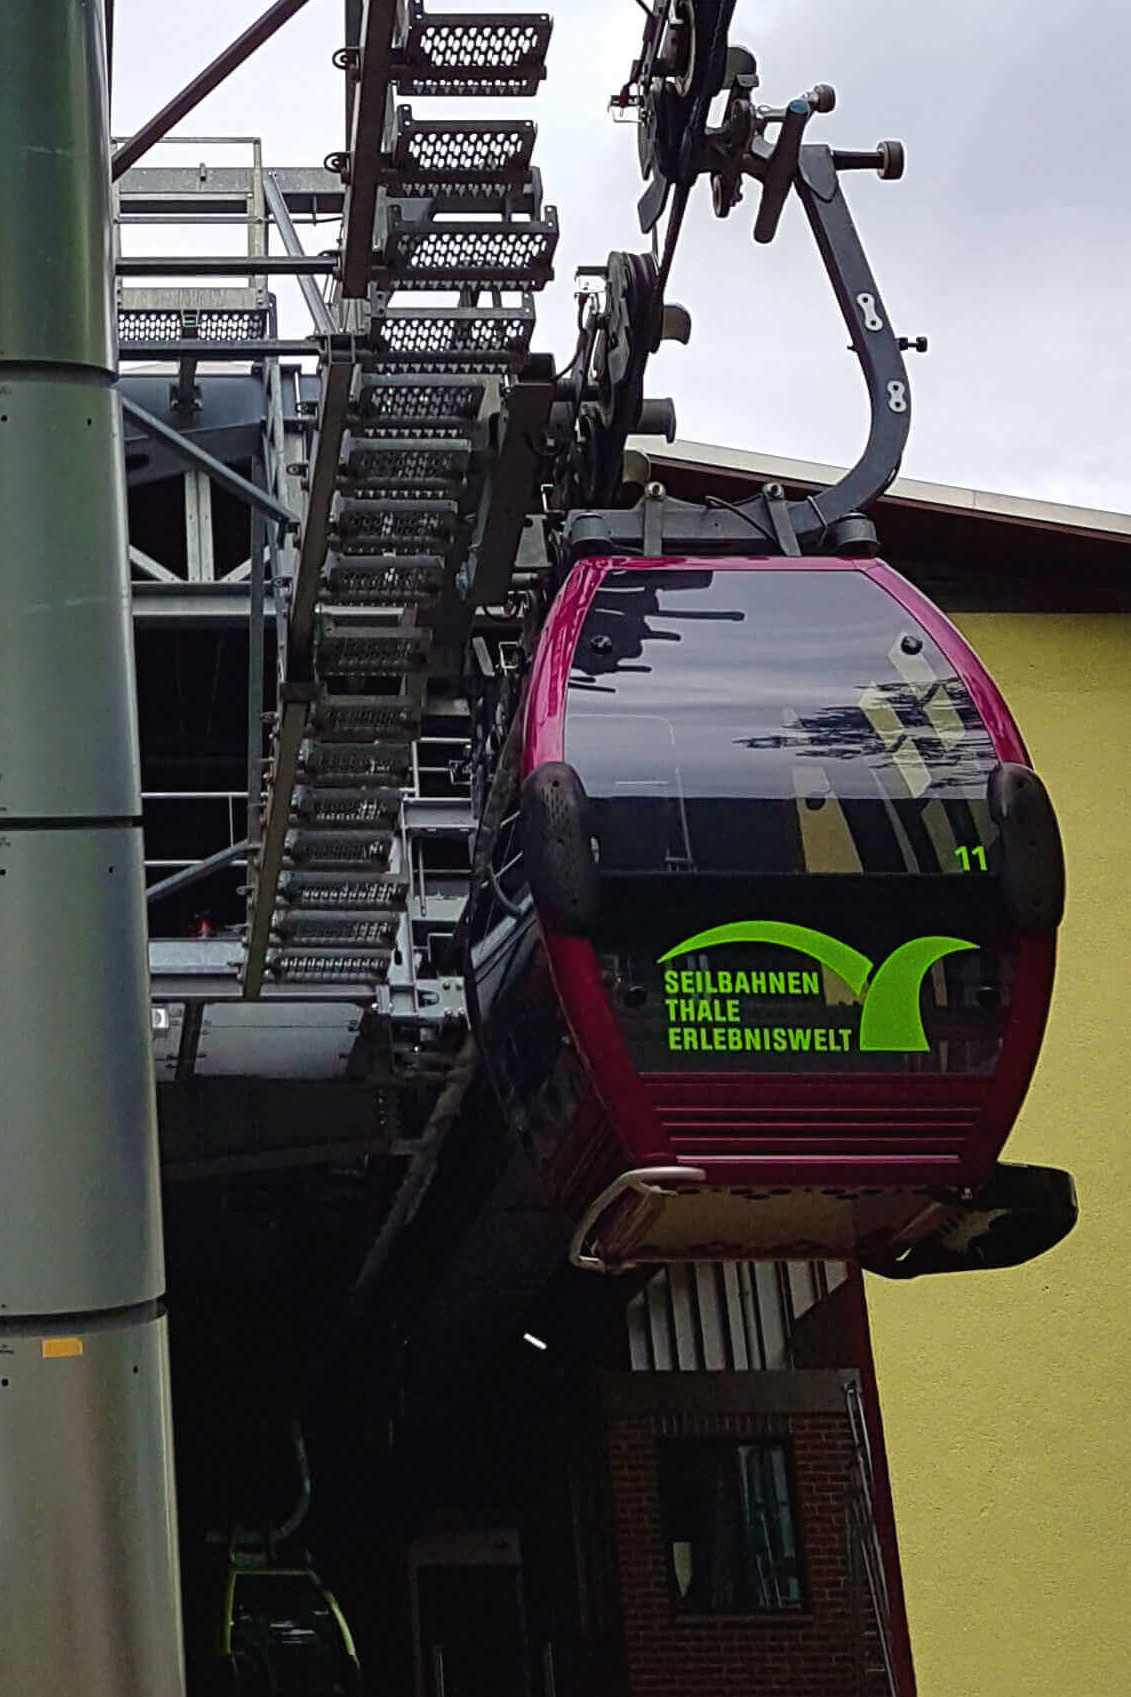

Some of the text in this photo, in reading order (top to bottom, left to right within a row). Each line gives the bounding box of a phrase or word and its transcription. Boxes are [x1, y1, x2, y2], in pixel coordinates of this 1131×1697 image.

[954, 845, 988, 871] 11
[664, 970, 820, 995] SEILBAHNEN
[665, 998, 741, 1023] THALE
[668, 1027, 853, 1052] ERLEBNISWELT
